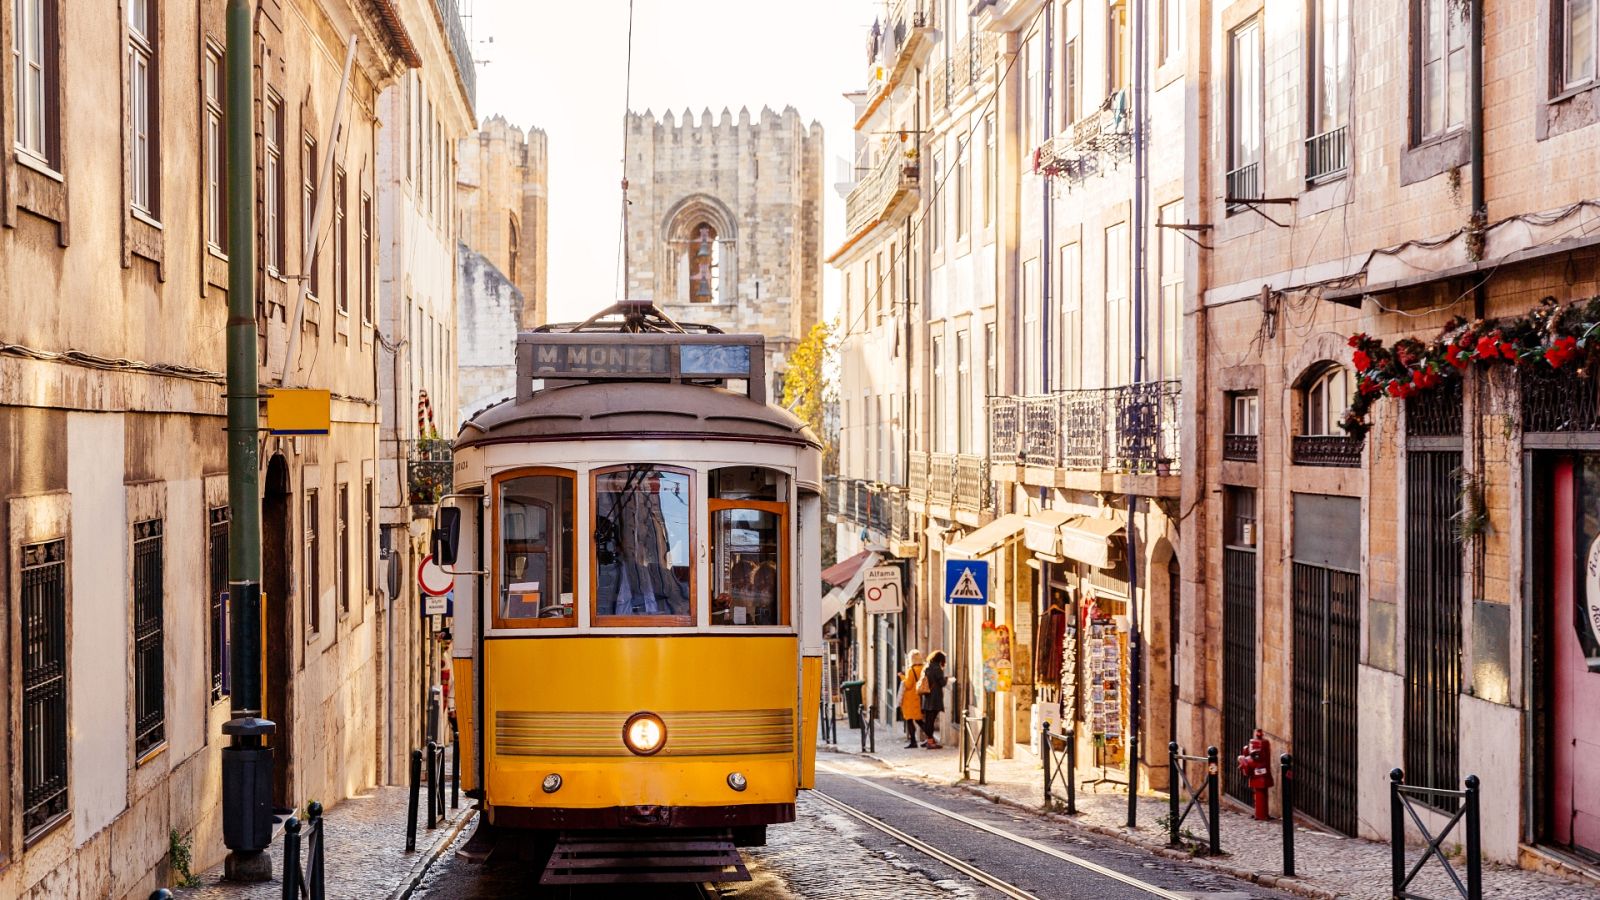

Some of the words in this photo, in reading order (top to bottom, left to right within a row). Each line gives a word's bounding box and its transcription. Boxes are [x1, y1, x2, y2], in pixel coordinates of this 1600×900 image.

[538, 345, 562, 363] M.
[568, 346, 652, 366] MONIZ
[686, 347, 729, 373] 28
